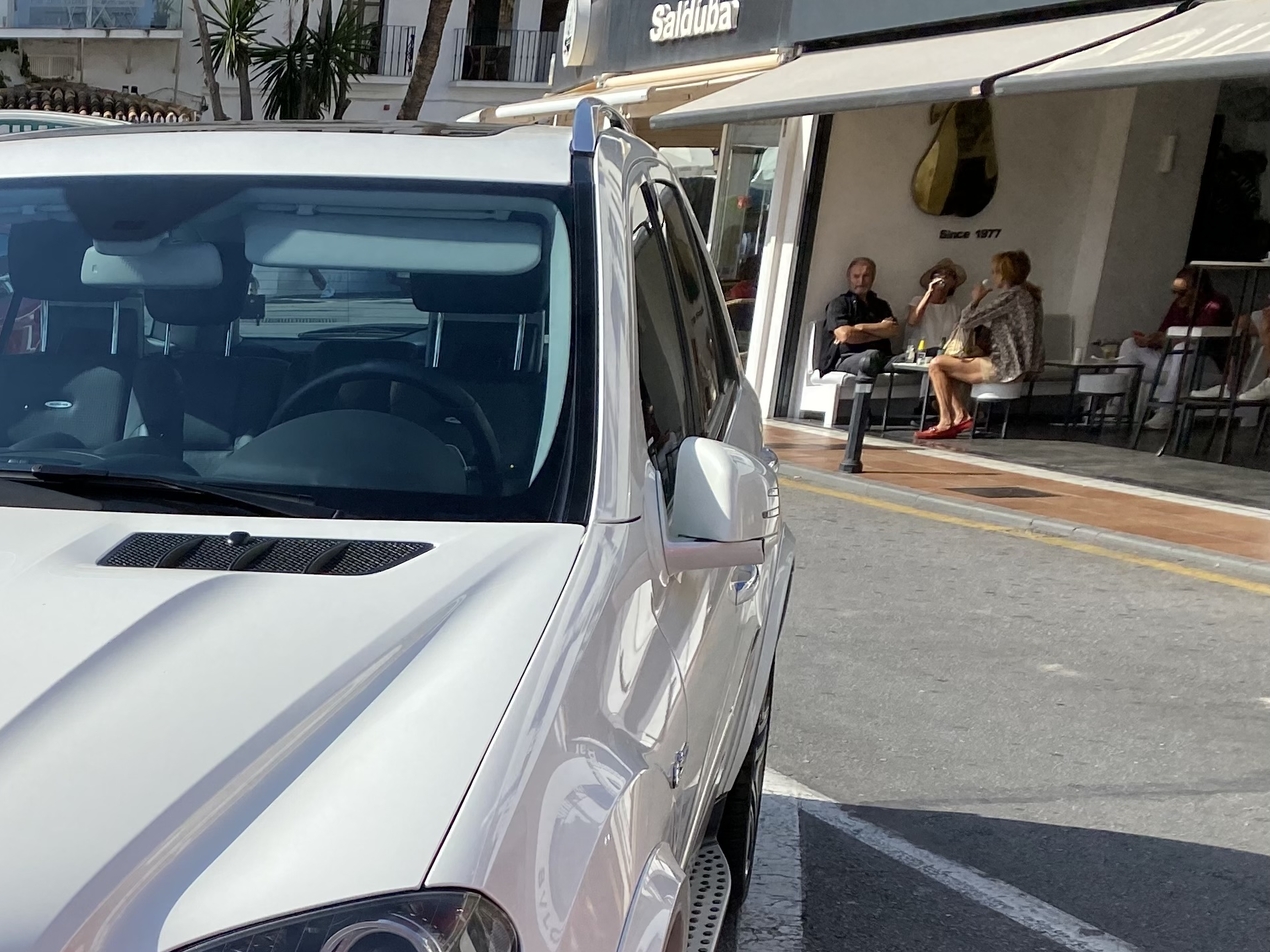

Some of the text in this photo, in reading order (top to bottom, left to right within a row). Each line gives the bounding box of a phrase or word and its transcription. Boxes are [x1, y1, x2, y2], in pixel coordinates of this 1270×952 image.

[650, 0, 739, 42] Salduba
[939, 228, 1002, 239] Since 1977
